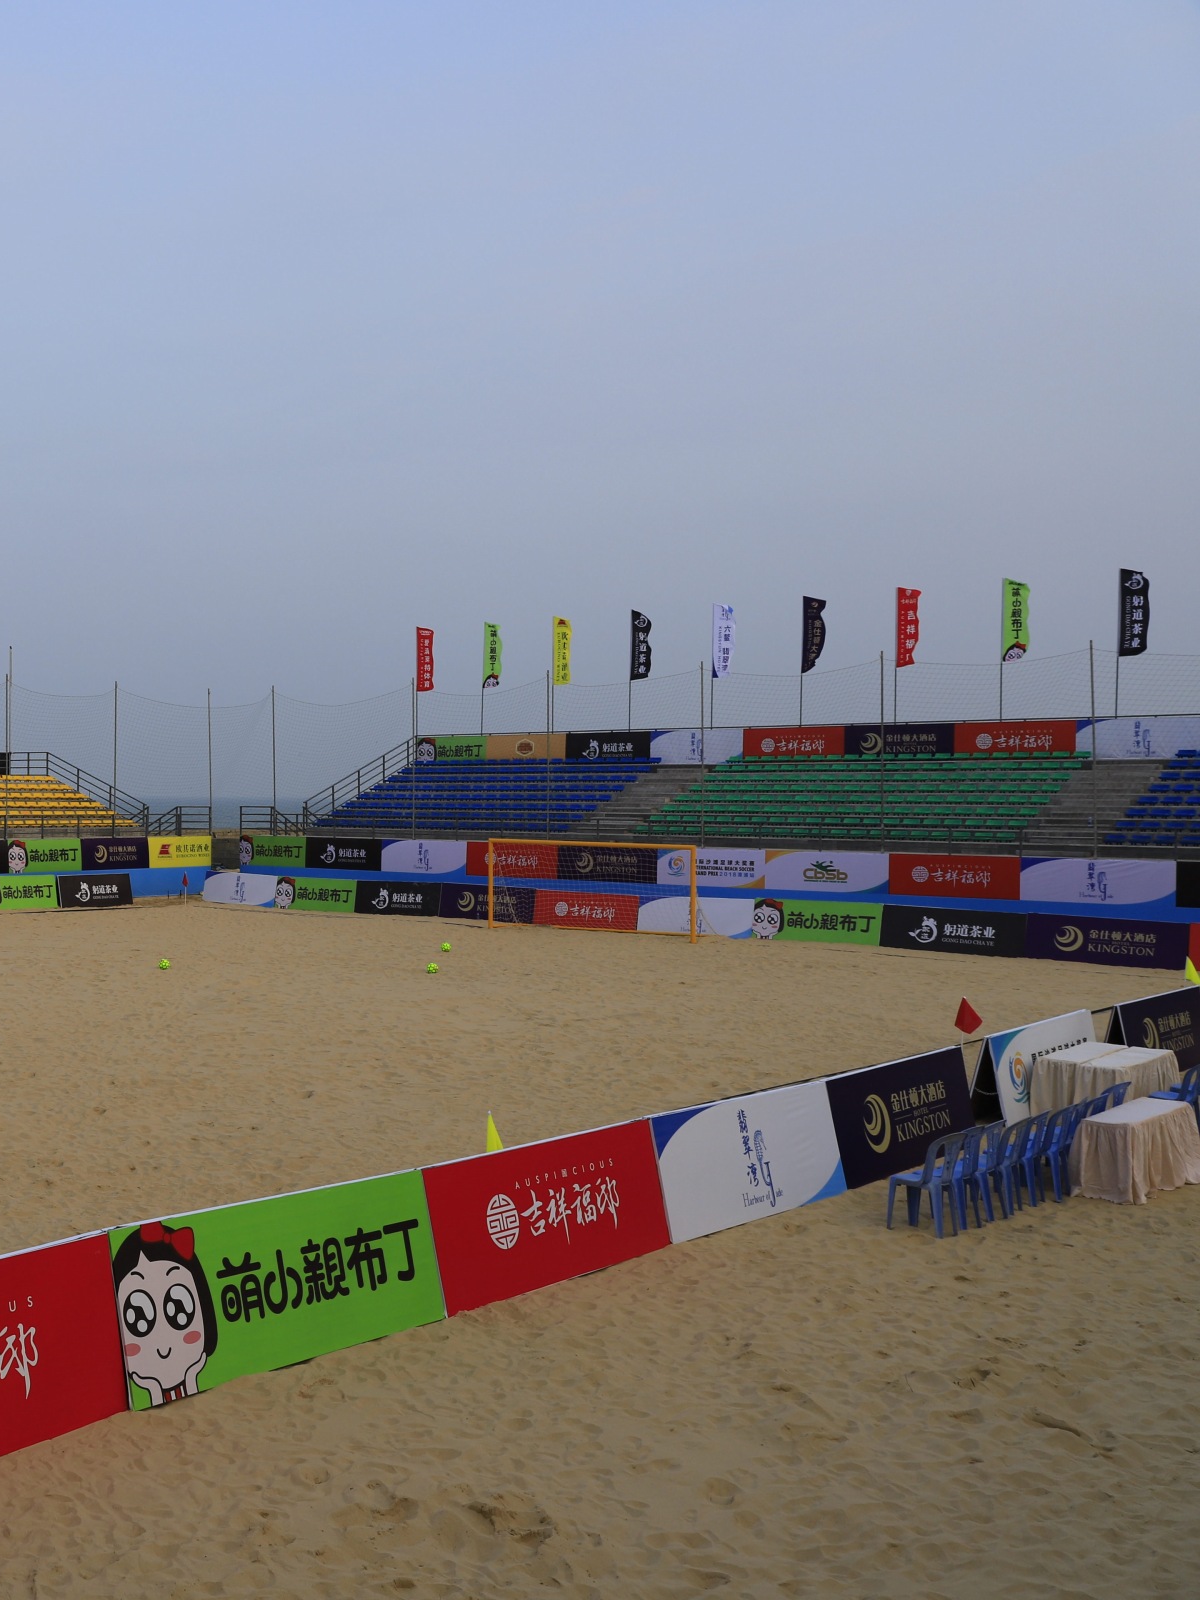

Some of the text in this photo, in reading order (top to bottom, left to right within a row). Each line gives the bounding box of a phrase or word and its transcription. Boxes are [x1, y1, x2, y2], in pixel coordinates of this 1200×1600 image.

[885, 745, 936, 753] KINGSTON
[994, 735, 1053, 750] 吉祥福邸
[29, 848, 78, 863] 萌小親布丁
[255, 845, 303, 858] 萌小親布丁
[930, 868, 991, 888] 吉祥福邸
[3, 884, 53, 899] 萌小親布丁
[297, 887, 352, 903] 萌小親布丁
[787, 911, 876, 933] 萌小親布丁
[943, 923, 996, 939] 躬道茶业
[1089, 929, 1156, 944] 金仕顿大酒店
[1088, 943, 1155, 957] KINGSTON
[890, 1080, 946, 1113] 金仕顿大酒店
[896, 1110, 951, 1142] KINGSTON
[737, 1109, 759, 1187] 翡翠湾
[742, 1192, 765, 1207] Harbour
[521, 1177, 620, 1245] 吉祥福邸
[216, 1218, 419, 1324] 萌小親布丁
